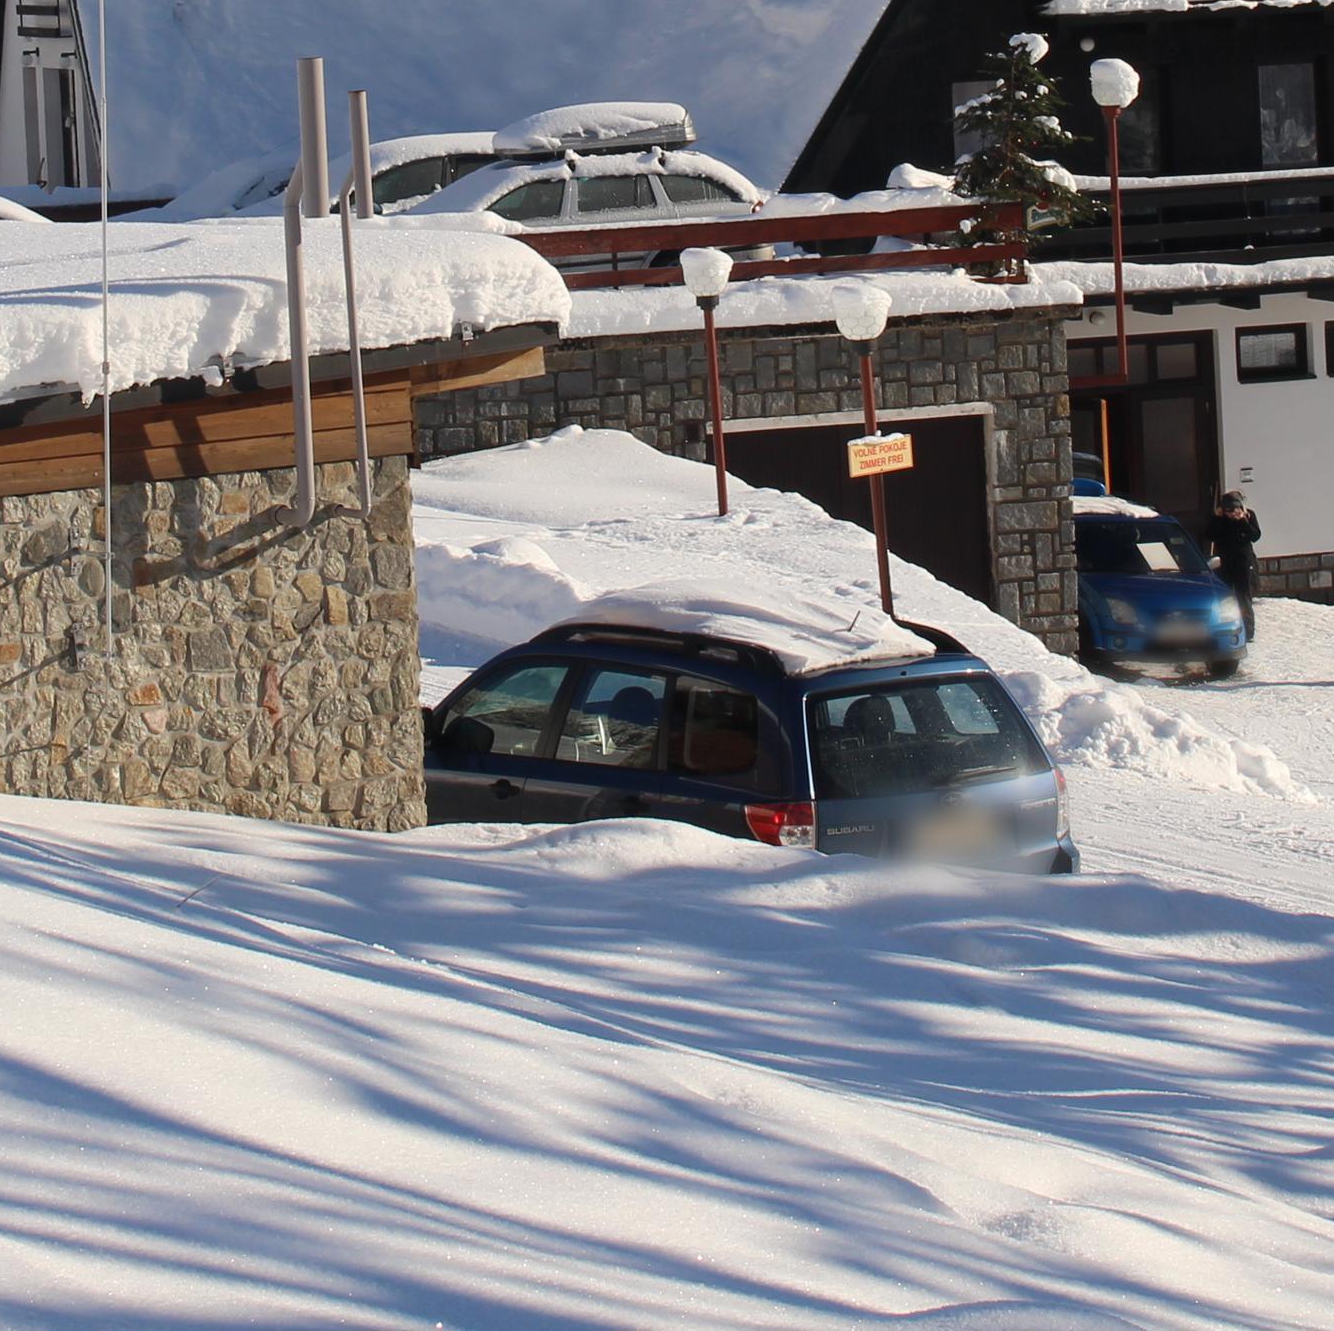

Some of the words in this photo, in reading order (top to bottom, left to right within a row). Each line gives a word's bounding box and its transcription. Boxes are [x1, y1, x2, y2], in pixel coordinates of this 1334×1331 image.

[879, 441, 907, 454] POKOJE
[860, 457, 886, 469] ZIMMER
[888, 454, 903, 464] FREI
